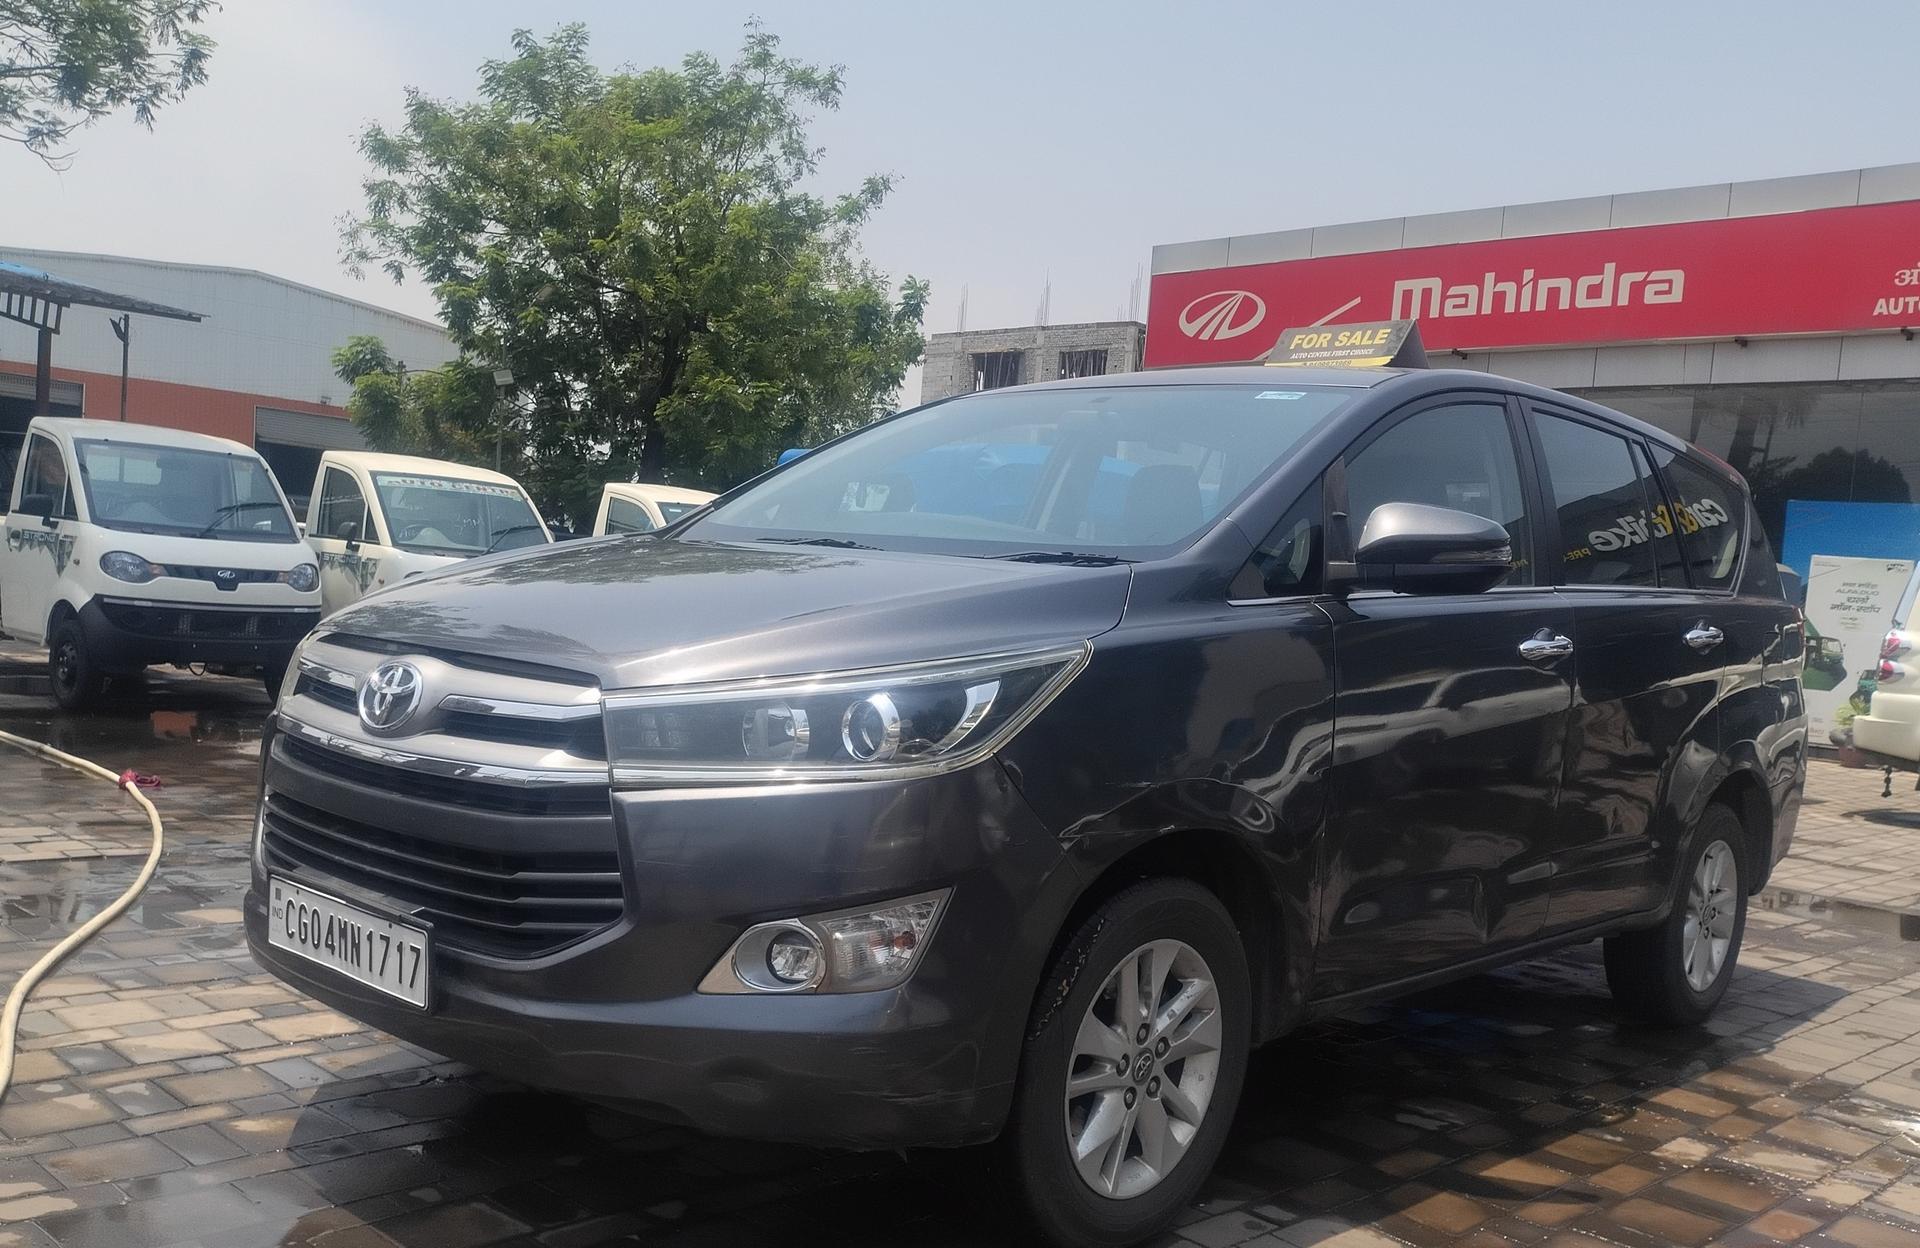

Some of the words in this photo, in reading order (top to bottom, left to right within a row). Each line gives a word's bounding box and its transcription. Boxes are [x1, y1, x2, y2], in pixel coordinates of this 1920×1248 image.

[1391, 262, 1685, 320] Mahindra
[1872, 296, 1920, 316] AUT
[1289, 333, 1332, 350] FOR
[1334, 328, 1392, 347] SALE
[1290, 352, 1309, 360] AUTO
[1308, 350, 1331, 359] CENTRE
[1331, 349, 1351, 358] FIRST
[1350, 348, 1375, 356] CHOICE
[23, 531, 57, 542] STRONG
[285, 898, 422, 989] CG04MN1717
